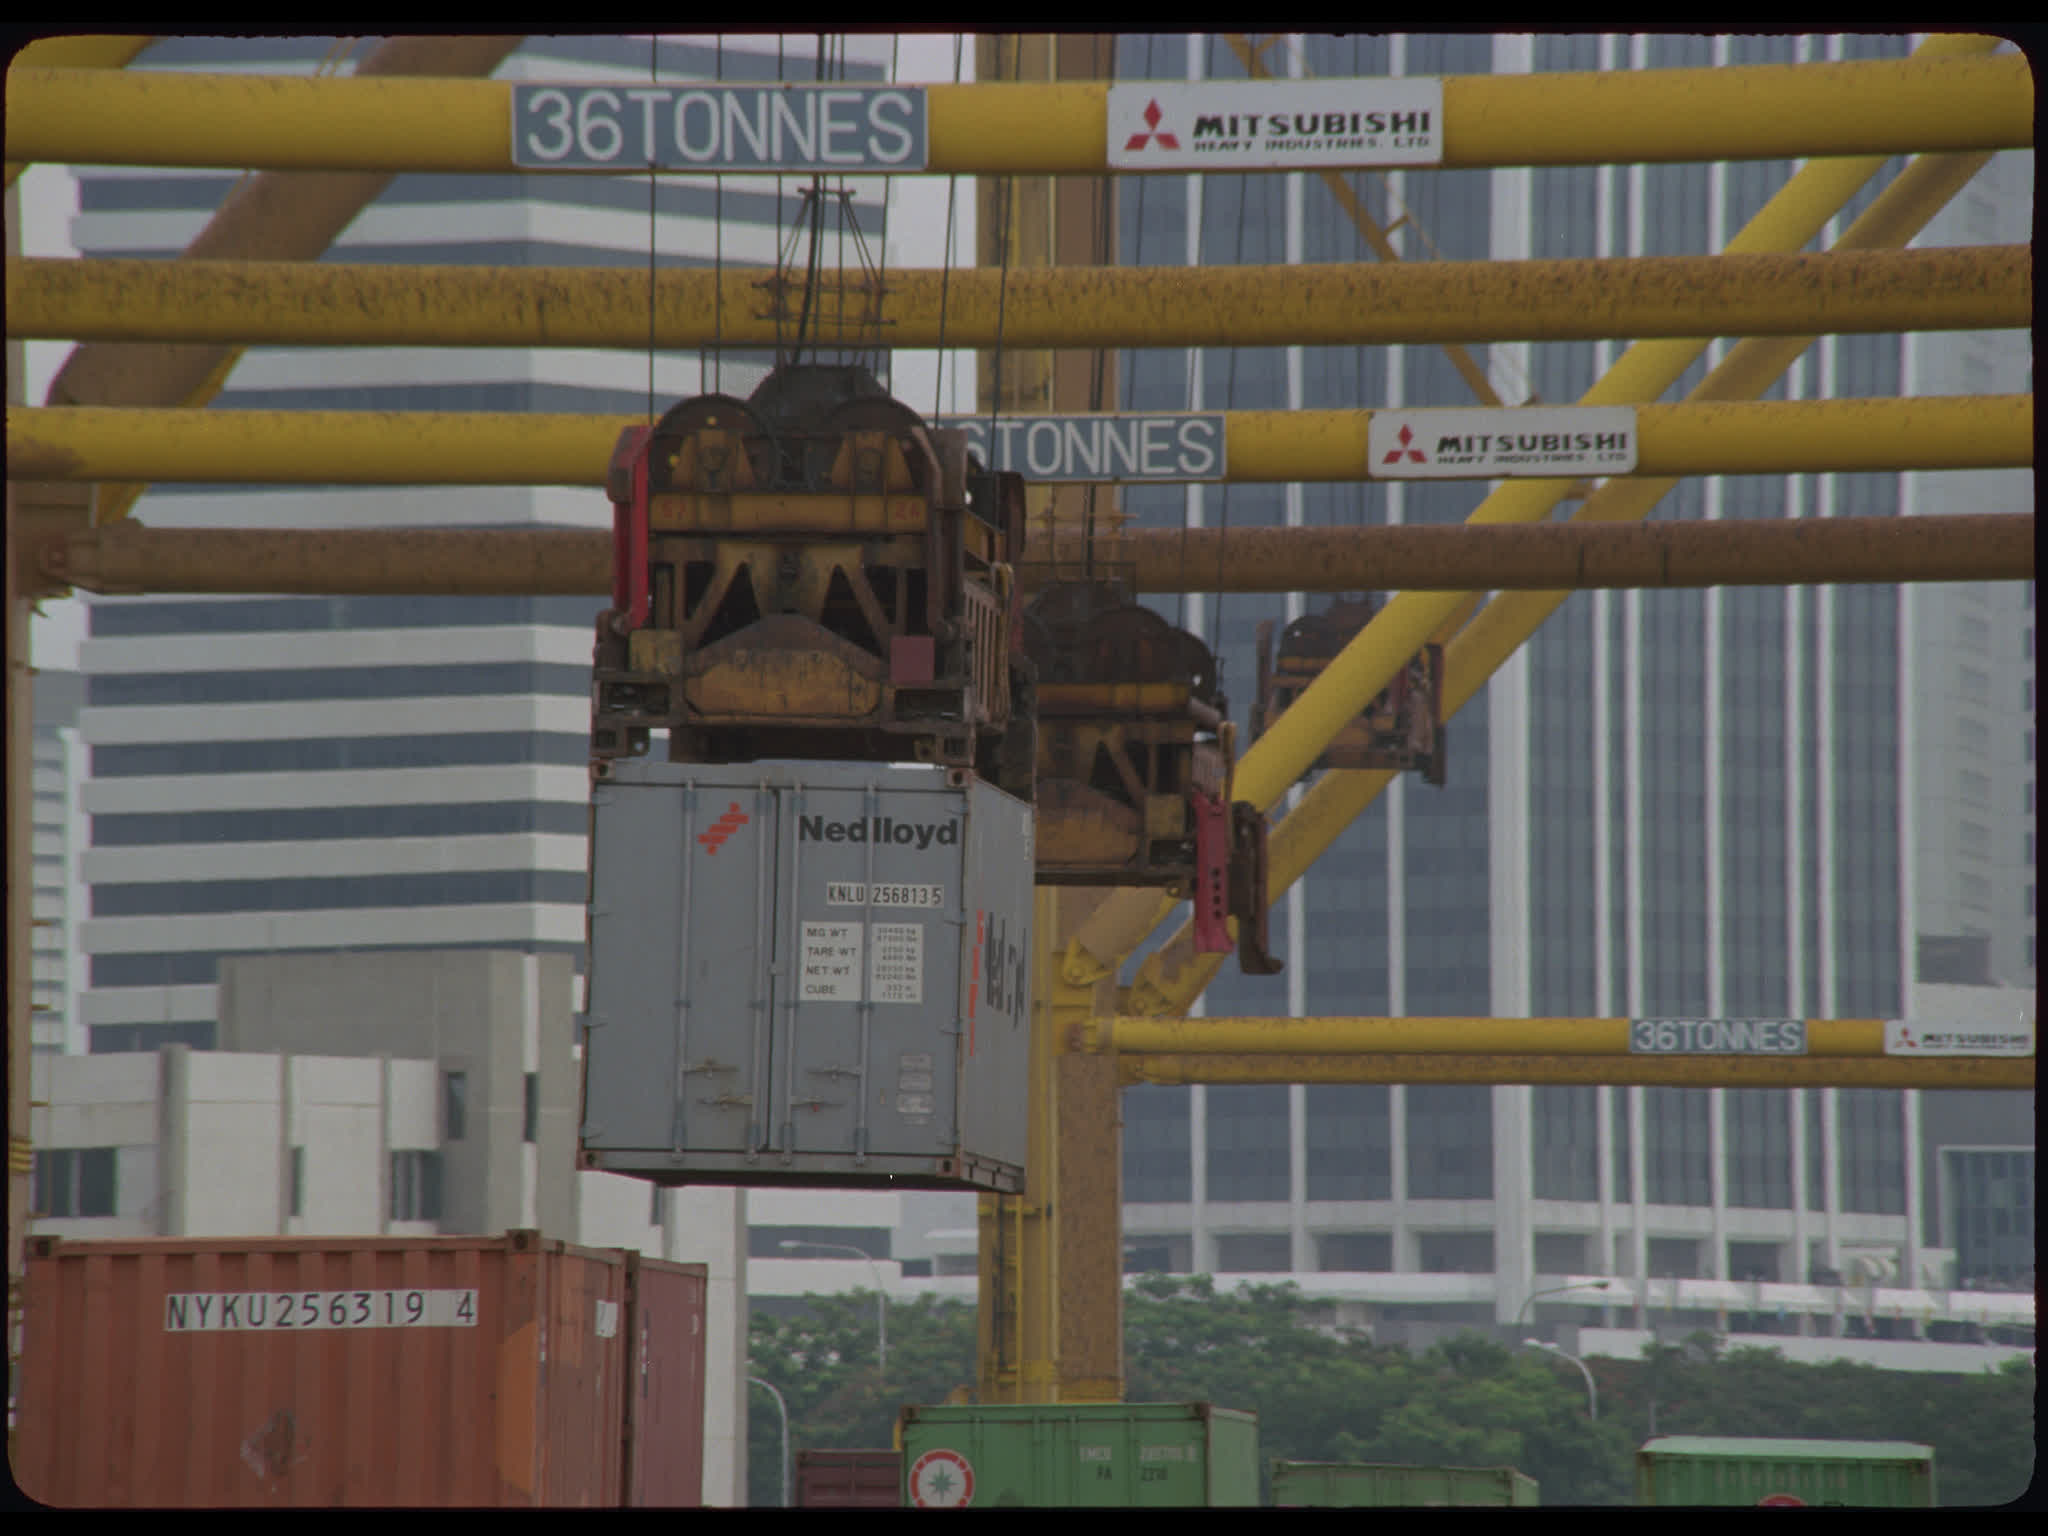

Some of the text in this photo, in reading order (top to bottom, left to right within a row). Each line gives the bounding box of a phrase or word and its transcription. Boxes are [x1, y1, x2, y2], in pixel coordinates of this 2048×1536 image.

[527, 89, 913, 163] 36TONNES
[1193, 110, 1431, 137] MITSUBISHI
[1194, 139, 1253, 152] HEAVY
[1436, 432, 1628, 453] MITSUBISHI
[799, 815, 958, 850] Nedlloyd
[828, 886, 864, 903] KNLU
[807, 946, 834, 957] TARE
[806, 966, 829, 976] NET
[805, 984, 837, 995] CUBE
[1636, 1021, 1799, 1050] 36TONNES
